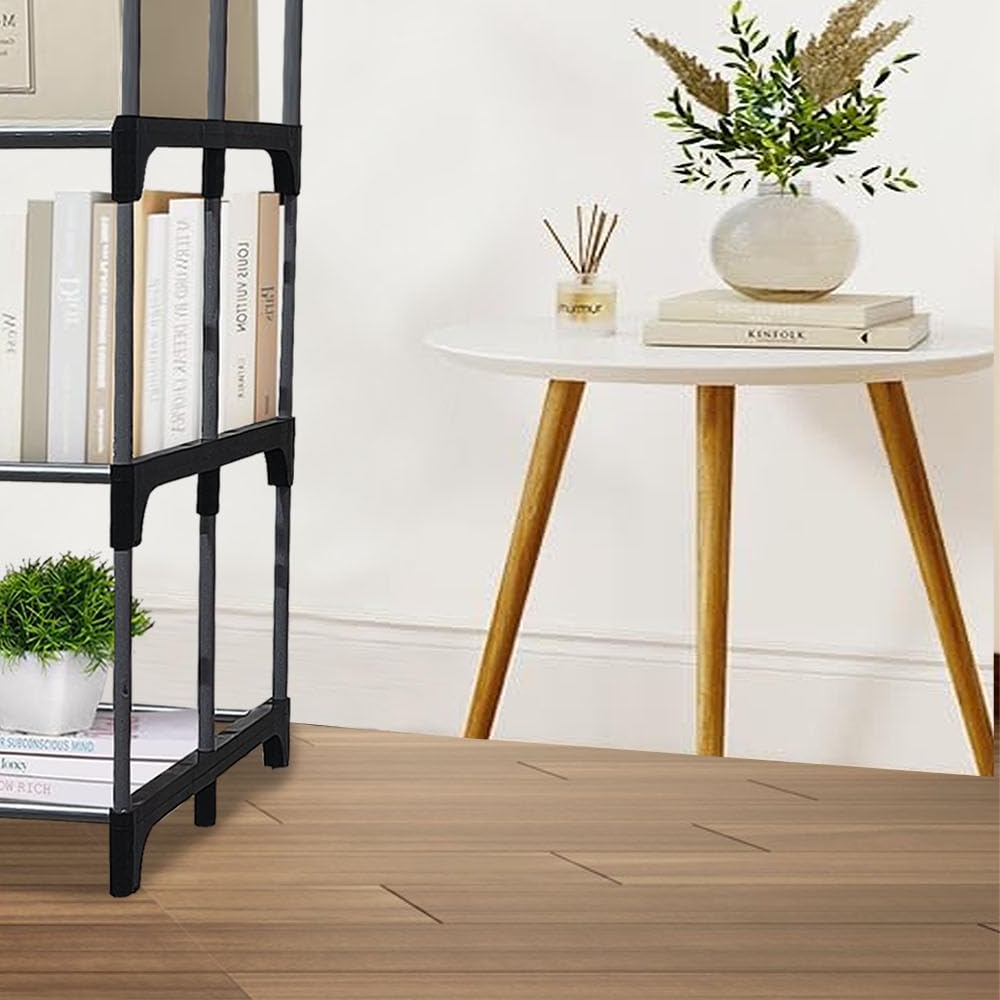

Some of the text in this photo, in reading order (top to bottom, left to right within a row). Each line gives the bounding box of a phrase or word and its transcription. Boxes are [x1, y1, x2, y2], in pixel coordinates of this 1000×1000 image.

[7, 738, 70, 751] SUBCONSCIOUS
[71, 740, 95, 752] MIND
[18, 782, 52, 795] RICH
